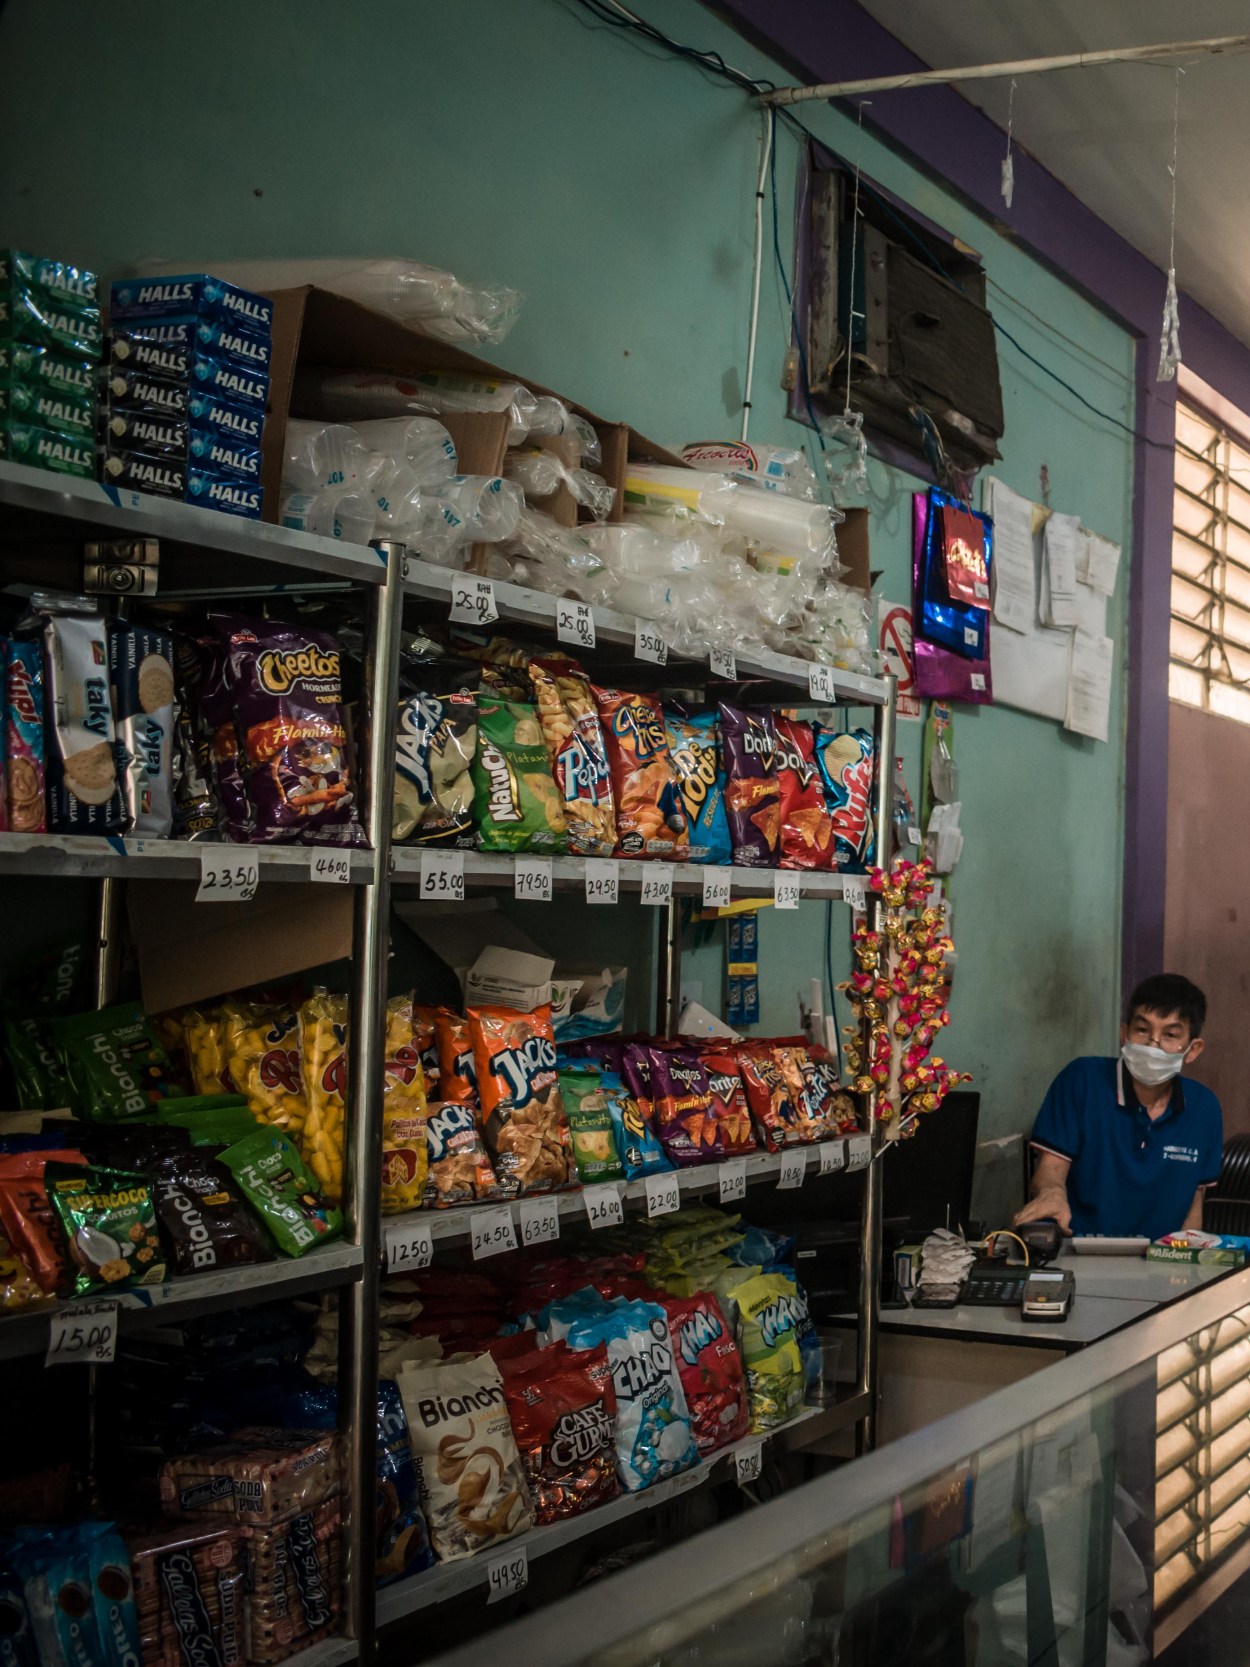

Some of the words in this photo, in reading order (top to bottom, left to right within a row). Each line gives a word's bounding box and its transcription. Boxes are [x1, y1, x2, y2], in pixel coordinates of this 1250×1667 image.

[40, 268, 97, 301] HALLS
[138, 283, 194, 303] HALLS
[222, 293, 270, 324] HALLS
[43, 310, 98, 341] HALLS
[136, 346, 188, 373] HALLS
[218, 332, 268, 363] HALLS
[39, 359, 94, 390] HALLS
[215, 370, 265, 401] HALLS
[133, 383, 185, 411] HALLS
[37, 398, 93, 429] HALLS
[209, 407, 259, 438] HALLS
[132, 421, 185, 448] HALLS
[37, 439, 93, 470] HALLS
[210, 447, 259, 475] HALLS
[129, 462, 183, 490] HALLS
[209, 483, 260, 511] HALLS
[455, 590, 489, 613] 25.00
[559, 612, 589, 635] 25.00
[128, 632, 136, 670] VAINILLA
[639, 633, 666, 654] 35.00
[259, 645, 341, 693] Cheetos
[81, 677, 111, 738] taky
[141, 718, 165, 778] taky
[396, 690, 444, 796] JACKS
[429, 718, 457, 758] PAPA
[51, 786, 60, 825] VAINILLA
[203, 866, 257, 889] 23.50
[315, 859, 348, 875] 46.00
[425, 871, 463, 892] 55.00
[517, 874, 549, 893] 79.50
[588, 879, 616, 896] 29.50
[644, 882, 669, 898] 43.00
[85, 1032, 146, 1115] Bianchi
[493, 1037, 558, 1102] JACKS
[669, 1068, 702, 1081] Doritos
[65, 1186, 149, 1212] SUPERCOCO
[239, 1164, 316, 1247] Bianchi
[590, 1201, 621, 1220] 26.00
[649, 1190, 678, 1211] 22.00
[86, 1206, 139, 1223] COQUITOS
[157, 1176, 217, 1269] Bianchi
[525, 1217, 557, 1240] 63.50
[475, 1226, 510, 1248] 24.50
[392, 1239, 429, 1264] 12.50
[1154, 1248, 1193, 1261] Alident
[54, 1325, 112, 1353] 15.00
[612, 1342, 672, 1400] CHAO
[418, 1378, 505, 1429] Bianchi
[642, 1380, 671, 1408] Original
[234, 1480, 263, 1498] SODA
[491, 1557, 525, 1588] 49.50
